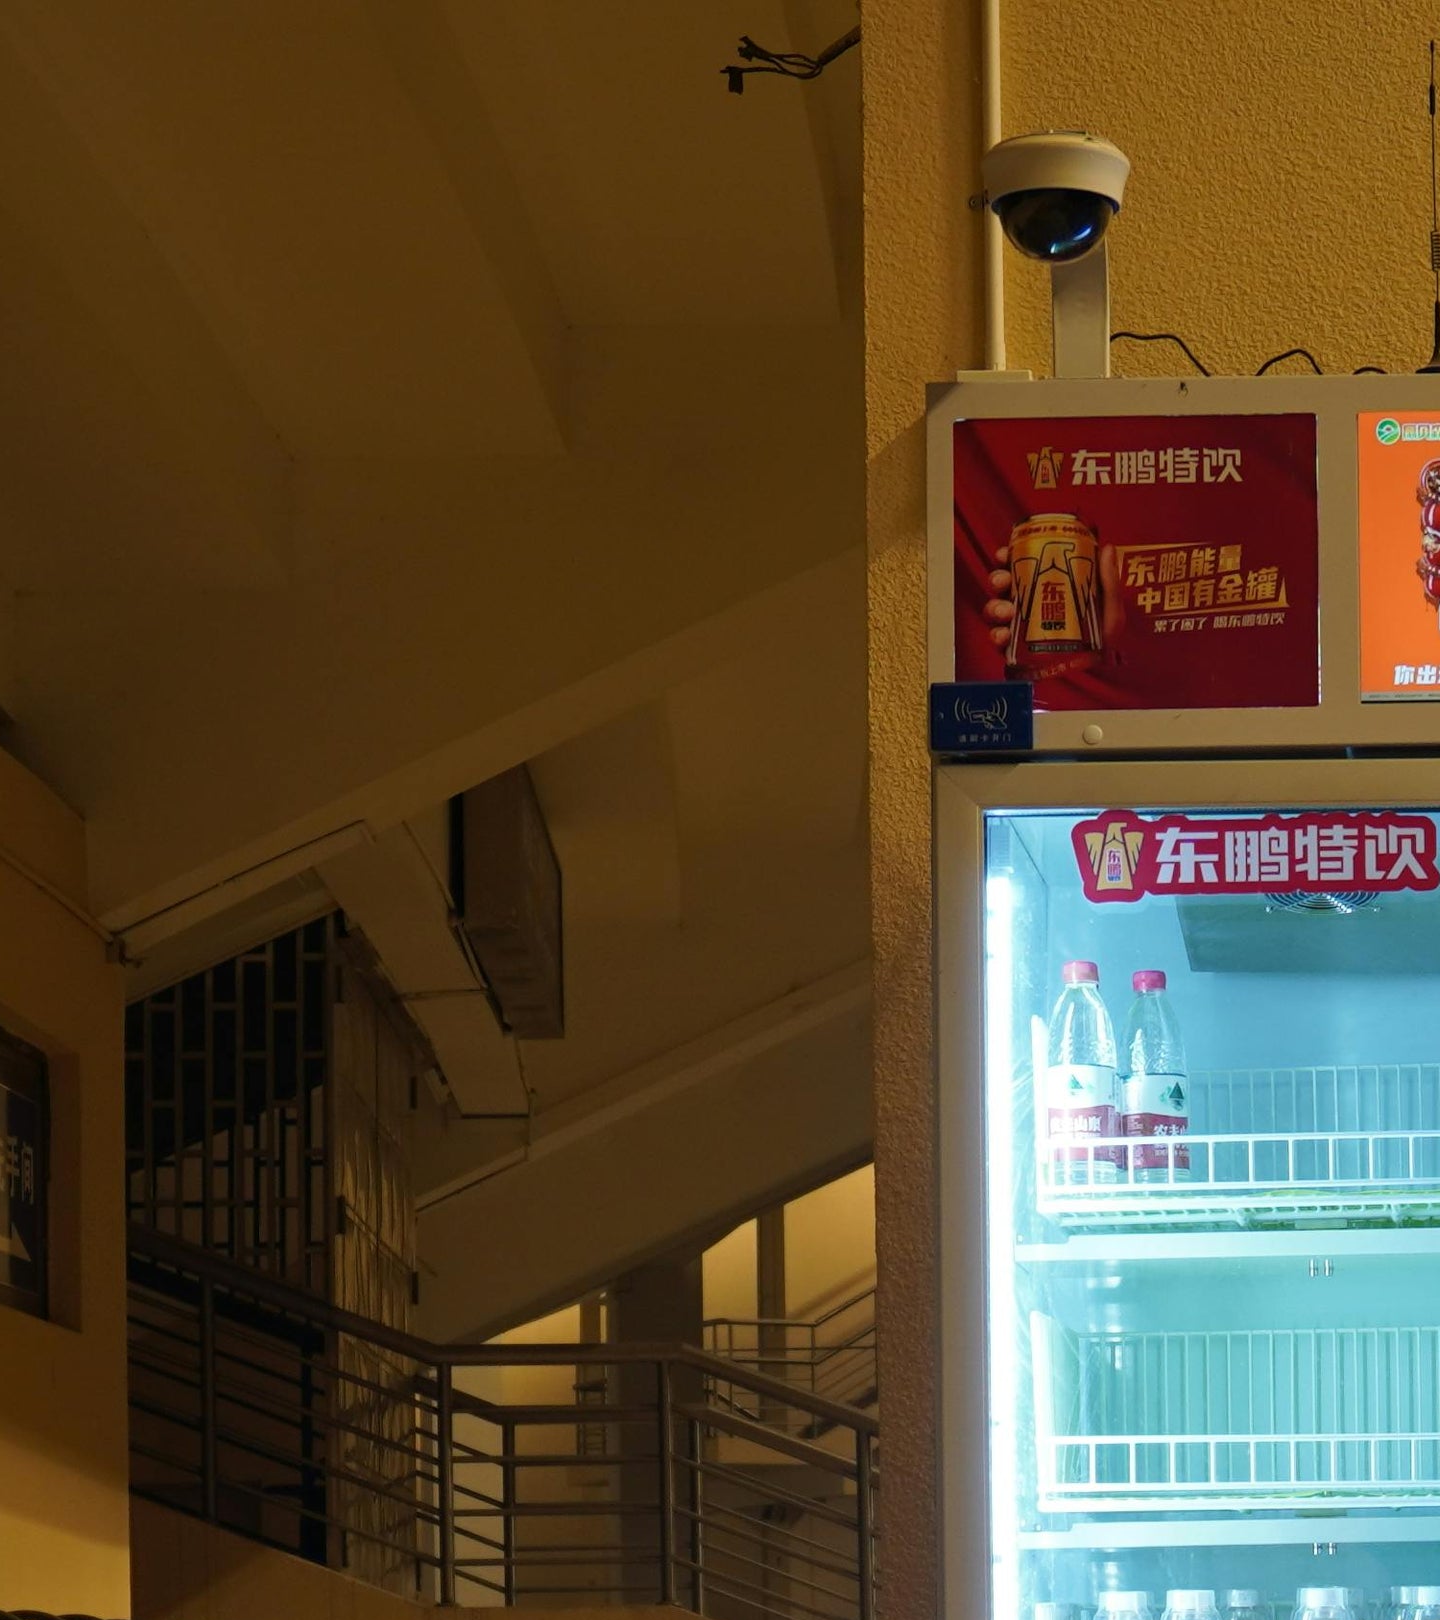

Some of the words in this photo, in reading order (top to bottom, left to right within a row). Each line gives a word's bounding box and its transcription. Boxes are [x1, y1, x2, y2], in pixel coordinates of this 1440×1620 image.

[1071, 447, 1243, 486] 东鹏特饮
[1125, 544, 1242, 588] 东鹏能量
[1137, 567, 1280, 613] 中国有金罐
[1155, 825, 1428, 883] 东鹏特饮
